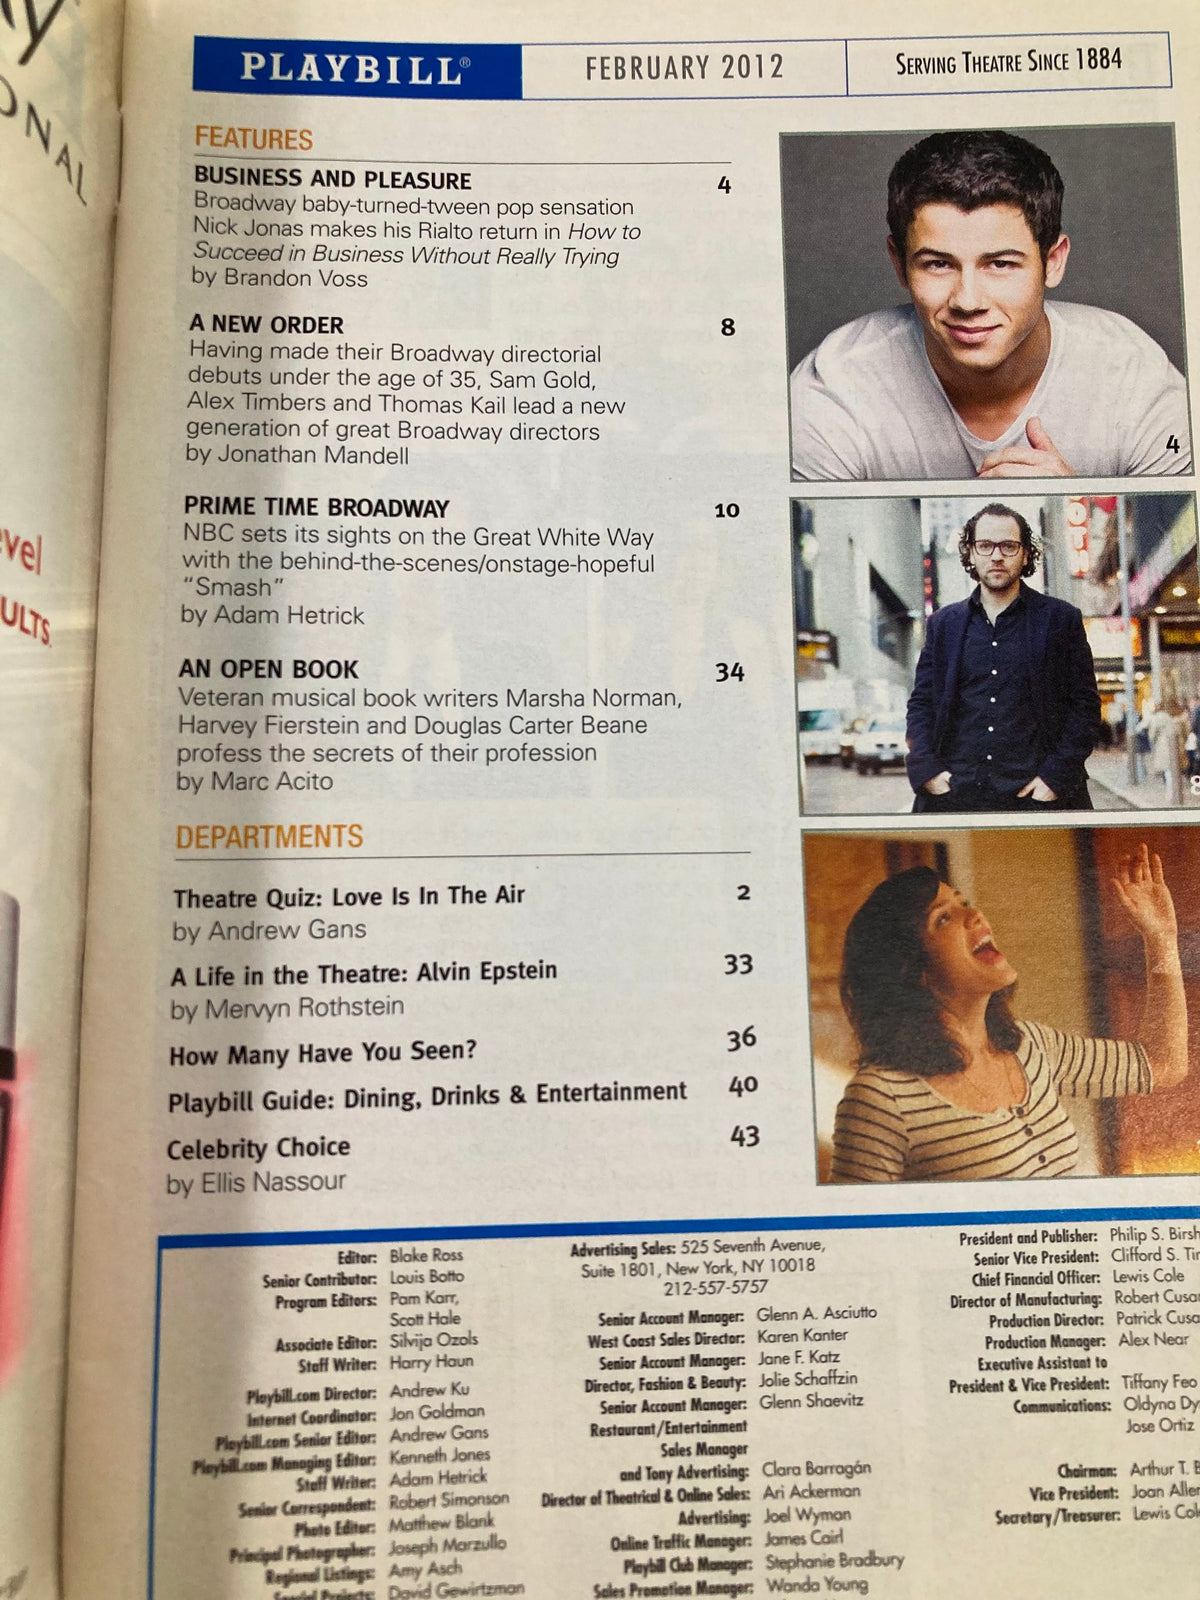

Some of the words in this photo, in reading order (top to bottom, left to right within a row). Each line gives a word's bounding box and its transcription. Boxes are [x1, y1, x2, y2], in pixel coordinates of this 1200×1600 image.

[586, 54, 709, 80] FEBRUARY
[721, 53, 783, 79] 2012
[896, 52, 956, 75] SERVING
[961, 51, 1022, 73] THEATRE
[1027, 48, 1069, 71] SINCE
[1076, 47, 1122, 70] 1884
[195, 124, 313, 151] FEATURES
[195, 165, 302, 186] BUSINESS
[310, 169, 355, 187] AND
[364, 170, 472, 190] PLEASURE
[717, 175, 731, 194] 4
[195, 190, 296, 217] Broadway
[302, 194, 490, 216] baby-turned-tween
[497, 202, 534, 219] pop
[539, 197, 633, 216] sensation
[194, 215, 238, 235] Nick
[243, 218, 304, 237] Jonas
[310, 219, 377, 238] makes
[384, 220, 411, 239] his
[419, 221, 473, 240] Rialto
[479, 224, 537, 240] return
[544, 222, 560, 240] in
[568, 222, 617, 240] How
[622, 224, 641, 240] to
[192, 265, 217, 288] by
[225, 267, 311, 287] Brandon
[318, 268, 368, 287] Voss
[189, 313, 205, 331] A
[212, 314, 262, 333] NEW
[270, 315, 344, 334] ORDER
[721, 317, 735, 336] 8
[190, 339, 262, 363] Having
[270, 341, 329, 360] made
[335, 342, 384, 360] their
[391, 343, 495, 367] Broadway
[501, 344, 601, 363] directorial
[186, 442, 212, 466] by
[217, 443, 316, 463] Jonathan
[324, 445, 408, 465] Mandell
[1166, 434, 1180, 454] 4
[184, 495, 255, 515] PRIME
[264, 497, 318, 516] TIME
[328, 497, 450, 518] BROADWAY
[714, 502, 740, 518] 10
[182, 550, 230, 569] with
[238, 550, 273, 569] the
[280, 551, 654, 577] behind-the-scenes/onstage-hopeful
[181, 603, 208, 627] by
[213, 604, 279, 624] Adam
[287, 605, 365, 625] Hetrick
[178, 658, 210, 678] AN
[220, 659, 282, 678] OPEN
[293, 659, 359, 679] BOOK
[715, 662, 745, 682] 34
[179, 714, 257, 739] Harvey
[265, 714, 359, 735] Fierstein
[366, 715, 406, 735] and
[414, 715, 502, 739] Douglas
[509, 715, 574, 735] Carter
[581, 714, 647, 734] Beane
[176, 771, 204, 795] by
[211, 770, 269, 791] Marc
[275, 770, 333, 791] Acito
[176, 823, 363, 849] DEPARTMENTS
[173, 888, 257, 908] Theatre
[266, 887, 322, 910] Quiz:
[333, 887, 382, 906] Love
[392, 886, 410, 906] Is
[419, 886, 438, 905] In
[447, 884, 487, 904] The
[495, 884, 525, 904] Air
[737, 884, 750, 900] 2
[173, 921, 201, 945] by
[208, 920, 301, 941] Andrew
[308, 918, 367, 940] Gans
[170, 999, 198, 1024] by
[205, 998, 290, 1023] Mervyn
[298, 994, 404, 1017] Rothstein
[169, 1090, 253, 1118] Playbill
[262, 1089, 334, 1111] Guide:
[344, 1086, 421, 1112] Dining,
[431, 1084, 500, 1106] Drinks
[509, 1084, 527, 1104] &
[536, 1080, 687, 1103] Entertainment
[728, 1075, 758, 1098] 40
[167, 1137, 268, 1164] Celebrity
[276, 1135, 351, 1157] Choice
[730, 1125, 760, 1147] 43
[570, 1242, 638, 1260] Advertising
[641, 1240, 676, 1255] Sales:
[680, 1239, 709, 1254] 525
[713, 1236, 766, 1254] Seventh
[959, 1230, 1013, 1246] President
[1016, 1229, 1038, 1244] and
[1041, 1228, 1098, 1243] Publisher:
[337, 1249, 377, 1265] Editor:
[389, 1246, 428, 1264] Blake
[432, 1247, 464, 1262] Ross
[262, 1273, 301, 1289] Senior
[304, 1271, 377, 1287] Contributor:
[390, 1269, 425, 1285] Louis
[429, 1268, 465, 1283] Botto
[581, 1263, 615, 1279] Suite
[666, 1261, 699, 1276] New
[742, 1258, 764, 1273] NY
[770, 1257, 816, 1273] 10018
[971, 1271, 1001, 1287] Chief
[1004, 1270, 1054, 1286] Financial
[1056, 1269, 1100, 1285] Officer:
[1112, 1269, 1150, 1283] Lewis
[1152, 1266, 1184, 1283] Cole
[663, 1278, 769, 1296] 212-557-5757
[274, 1337, 334, 1352] Associate
[337, 1334, 377, 1350] Editor:
[389, 1331, 432, 1352] Silvija
[436, 1329, 479, 1347] Ozols
[757, 1329, 799, 1343] Karen
[803, 1327, 848, 1342] Kanter
[985, 1334, 1047, 1350] Production
[1050, 1333, 1106, 1351] Manager:
[1118, 1330, 1150, 1347] Alex
[1153, 1331, 1189, 1346] Near
[758, 1371, 790, 1388] Jolie
[794, 1368, 858, 1387] Schaffzin
[1013, 1398, 1112, 1414] Communications:
[590, 1419, 748, 1438] Restaurant/Entertainment
[1125, 1418, 1155, 1433] Jose
[1158, 1417, 1195, 1433] Ortiz
[389, 1446, 447, 1465] Kenneth
[450, 1447, 491, 1463] Jones
[761, 1459, 801, 1478] Clara
[805, 1460, 872, 1480] Barragán
[389, 1492, 437, 1511] Robert
[440, 1491, 510, 1508] Simonson
[388, 1513, 451, 1533] Matthew
[454, 1510, 495, 1530] Blank
[994, 1507, 1121, 1528] Secretary/Treasurer:
[765, 1552, 835, 1574] Stephanie
[838, 1550, 905, 1570] Bradbury
